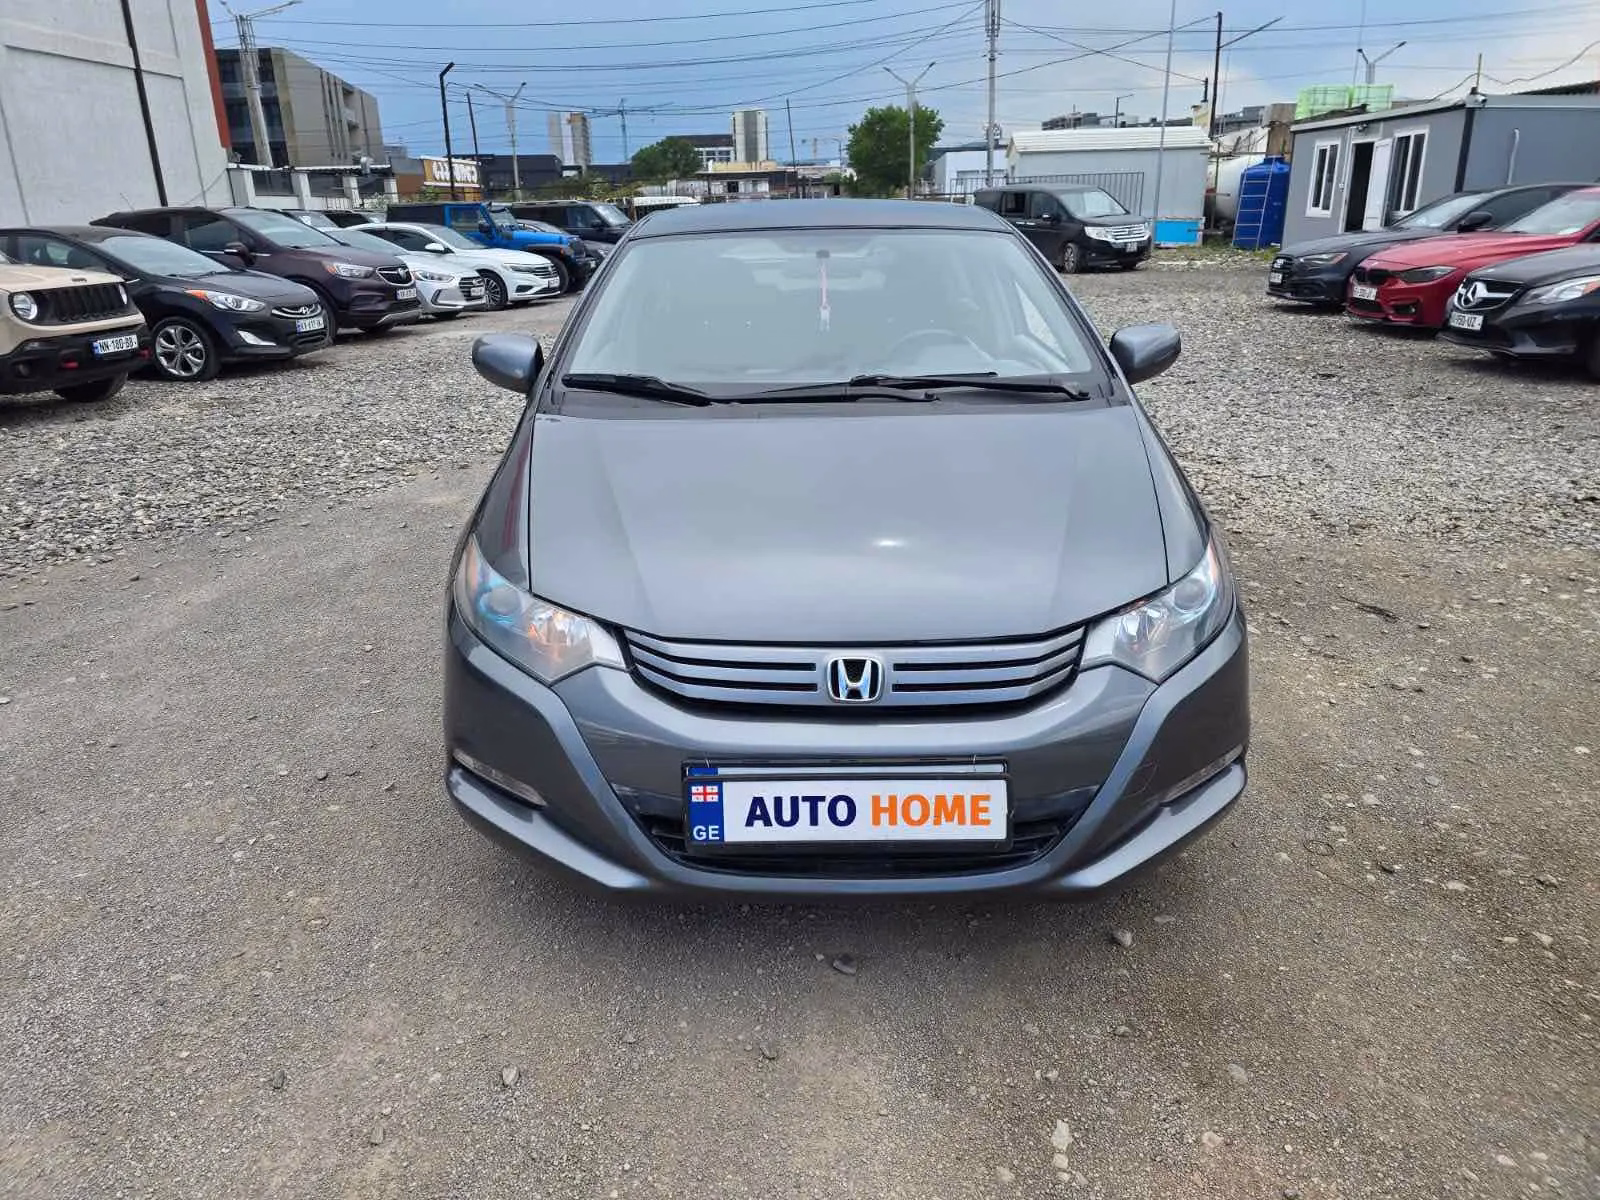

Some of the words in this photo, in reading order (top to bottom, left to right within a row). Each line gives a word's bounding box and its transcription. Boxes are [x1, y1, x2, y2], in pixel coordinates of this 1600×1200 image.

[744, 794, 857, 828] AUTO
[871, 794, 991, 826] HOME
[693, 825, 720, 841] GE
